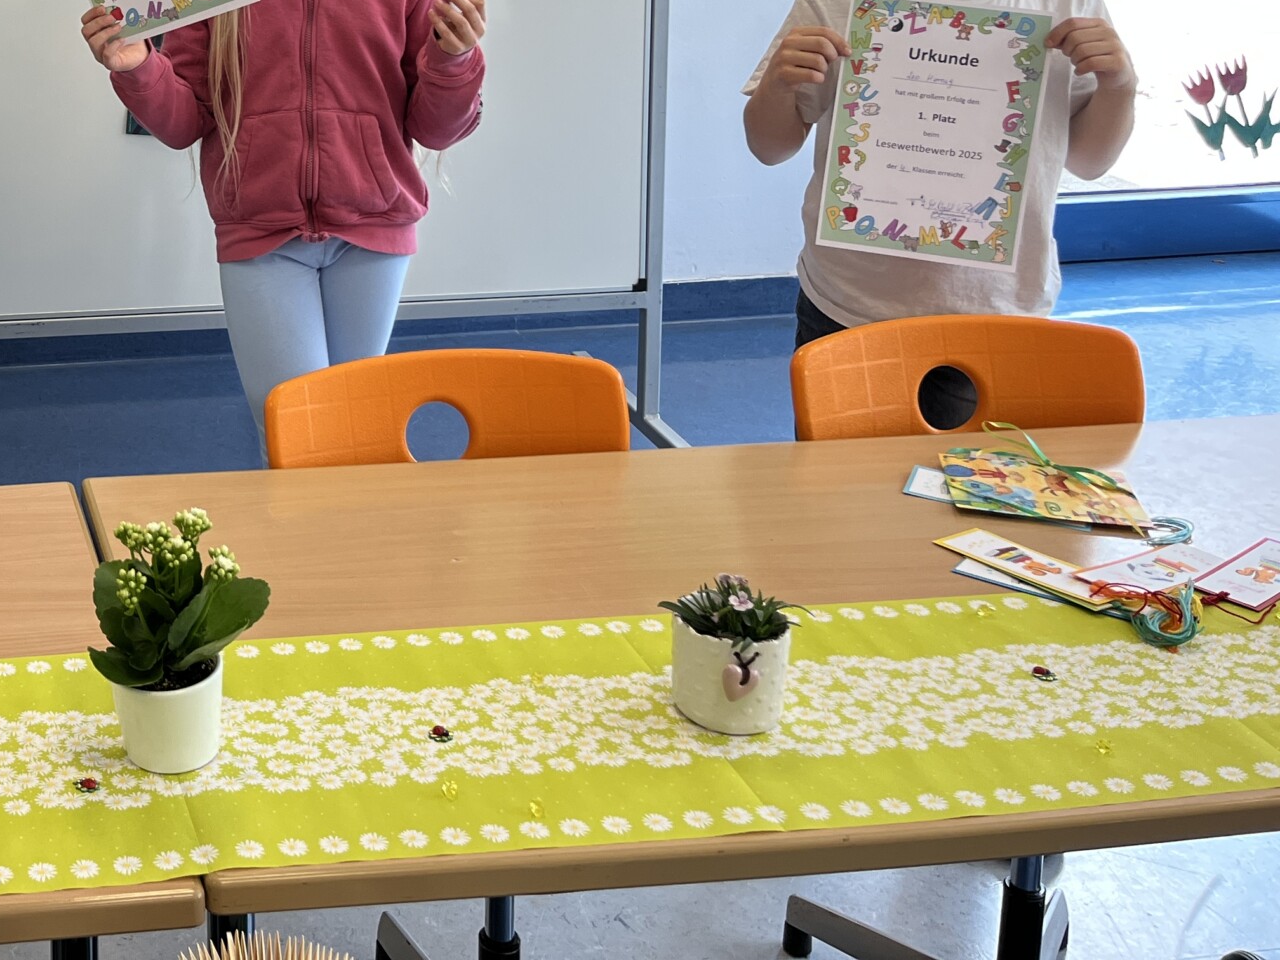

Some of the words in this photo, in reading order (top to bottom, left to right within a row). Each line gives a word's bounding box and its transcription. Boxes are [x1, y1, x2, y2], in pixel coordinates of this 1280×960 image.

[909, 48, 979, 67] Urkunde
[895, 89, 906, 97] hat
[920, 92, 945, 101] großem
[947, 96, 965, 104] Erfolg
[918, 112, 926, 120] 1.
[932, 114, 956, 123] Platz
[876, 139, 956, 157] Lesewettbewerb
[958, 150, 982, 160] 2025
[912, 166, 936, 174] Klassen
